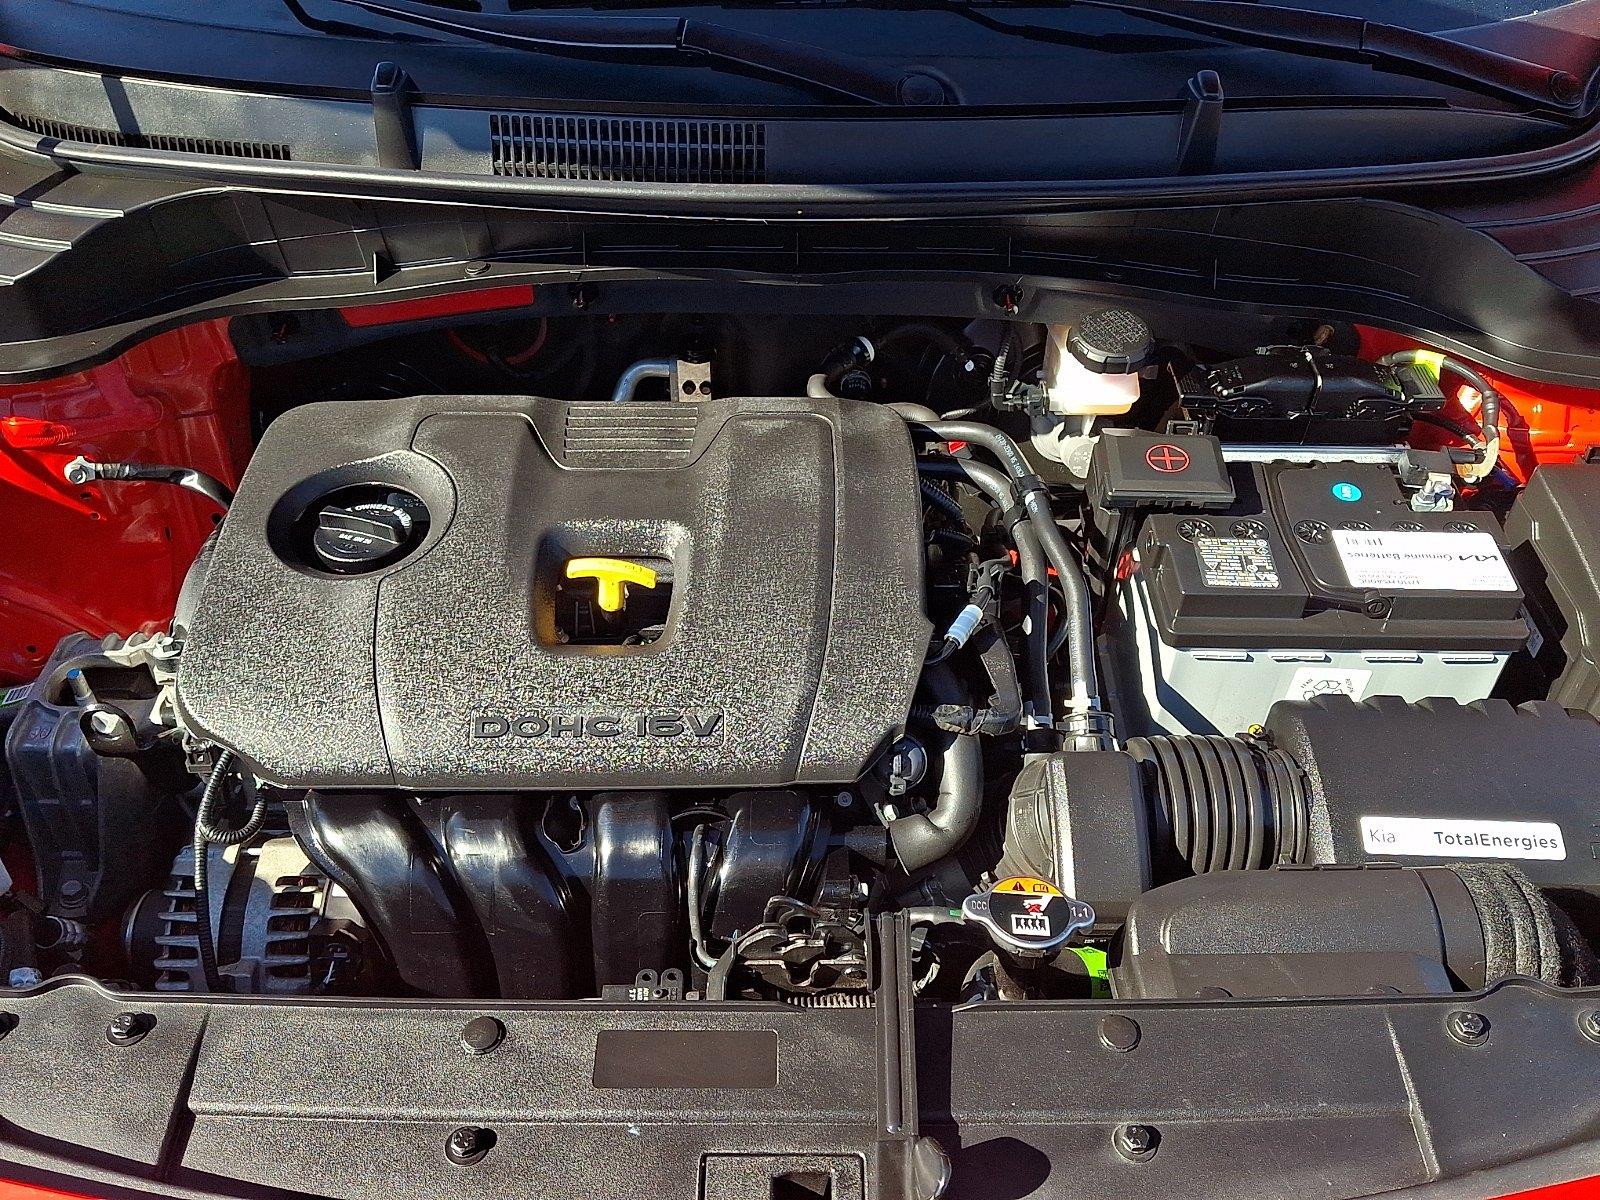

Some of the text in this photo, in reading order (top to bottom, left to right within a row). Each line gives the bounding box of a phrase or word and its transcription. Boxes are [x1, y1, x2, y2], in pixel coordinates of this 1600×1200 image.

[474, 713, 723, 738] DOHC 16V
[1369, 829, 1559, 850] Kia TotalEnergies
[971, 901, 988, 911] DCC
[1070, 906, 1089, 918] 1.1
